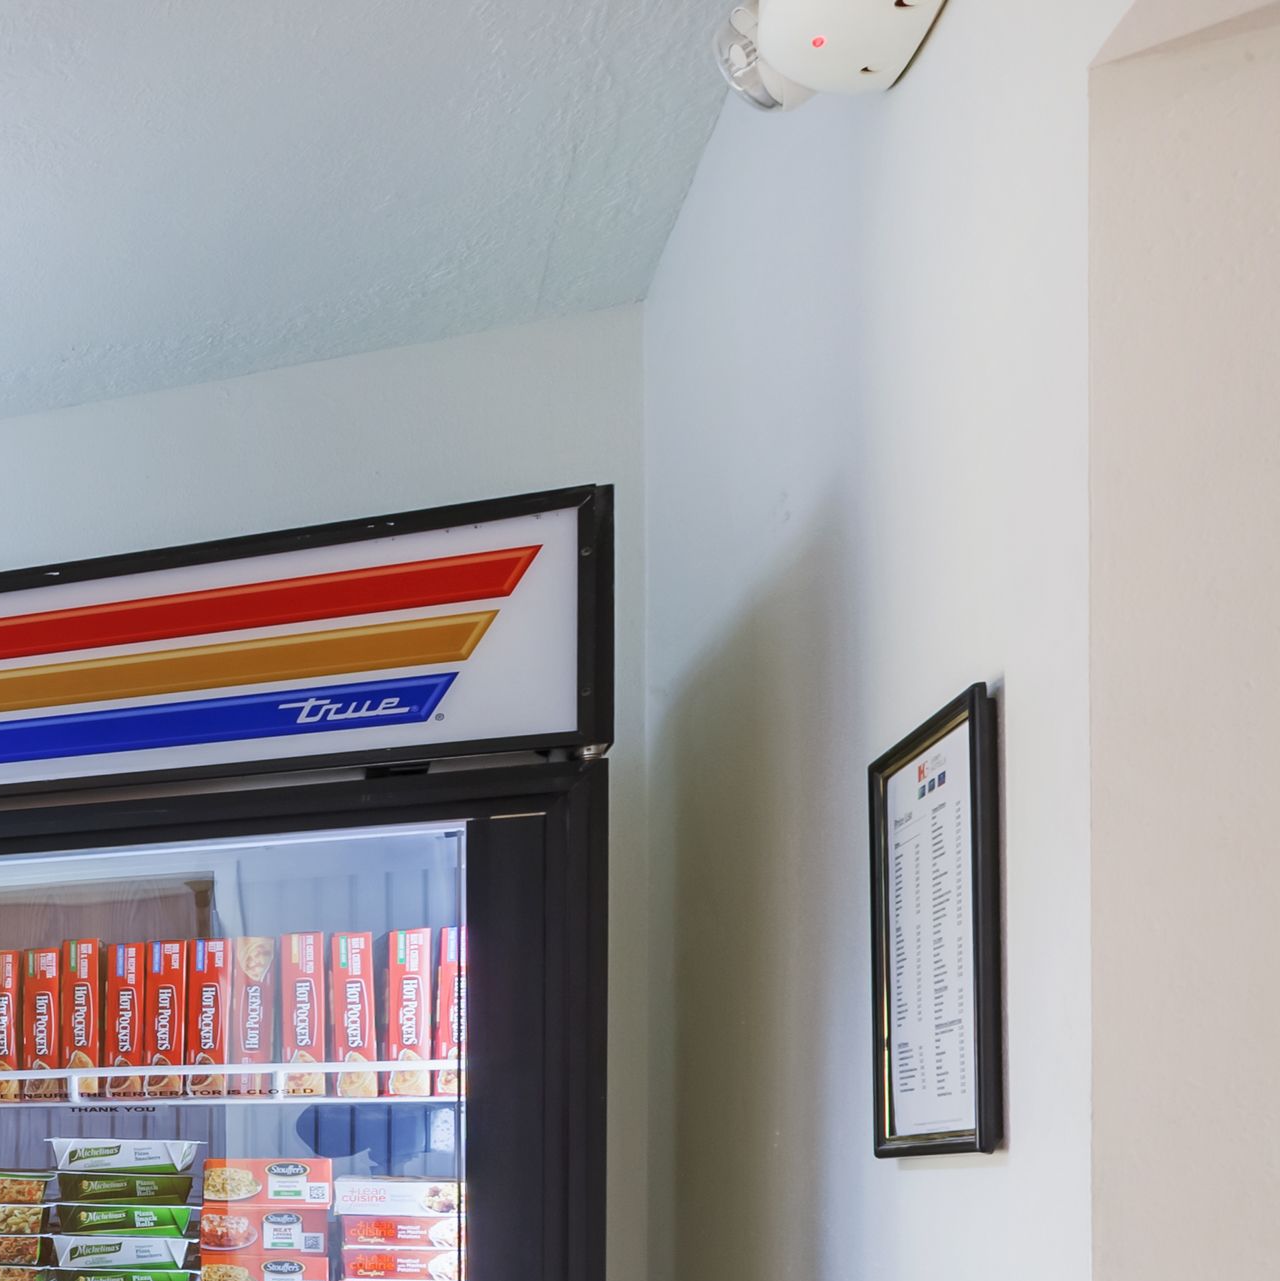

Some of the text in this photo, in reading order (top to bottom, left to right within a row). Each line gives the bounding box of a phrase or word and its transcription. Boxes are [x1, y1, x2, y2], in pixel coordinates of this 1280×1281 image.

[278, 697, 410, 723] true
[75, 985, 88, 1003] HOT
[35, 1014, 48, 1056] POCKETS
[74, 1005, 88, 1047] POCKETS
[118, 990, 132, 1052] HOT POCKETS
[158, 988, 171, 1051] HOT POCKETS
[200, 987, 216, 1050] HOT POCKETS
[15, 1092, 72, 1100] ENSURE
[247, 1087, 314, 1096] CLOSED
[267, 1164, 307, 1178] Stouffer's
[263, 1261, 302, 1275] Stouffer's
